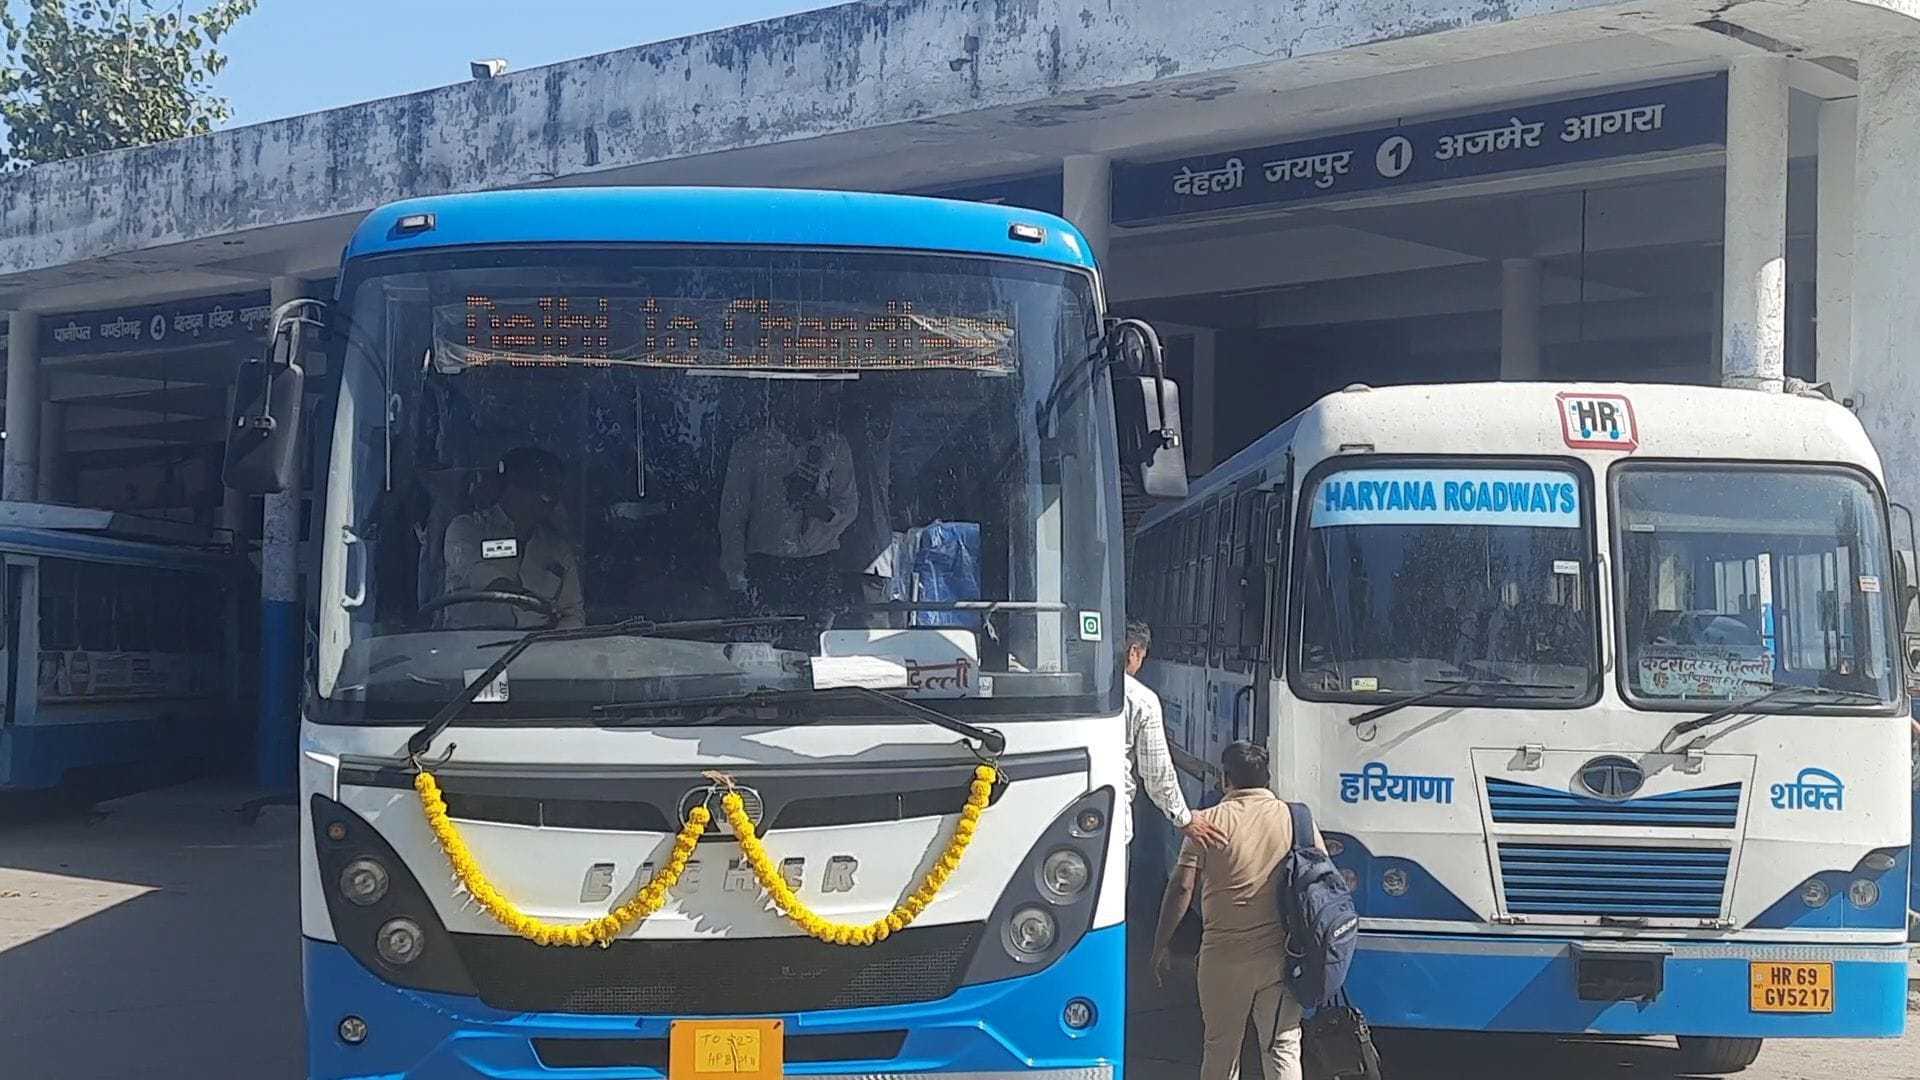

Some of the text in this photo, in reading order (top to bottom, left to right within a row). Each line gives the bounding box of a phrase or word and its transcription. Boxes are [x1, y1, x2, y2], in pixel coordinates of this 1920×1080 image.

[1173, 158, 1245, 195] देहली
[1262, 151, 1354, 188] जयपुर
[1435, 117, 1545, 160] अजमेर
[1560, 104, 1667, 142] आगरा
[1576, 401, 1618, 432] HR
[1325, 481, 1575, 513] HARYANA ROADWAYS
[1340, 762, 1455, 804] हरियाणा
[1770, 768, 1845, 811] शक्ति
[1771, 966, 1817, 985] HR 69
[1765, 988, 1830, 1007] GV5217
